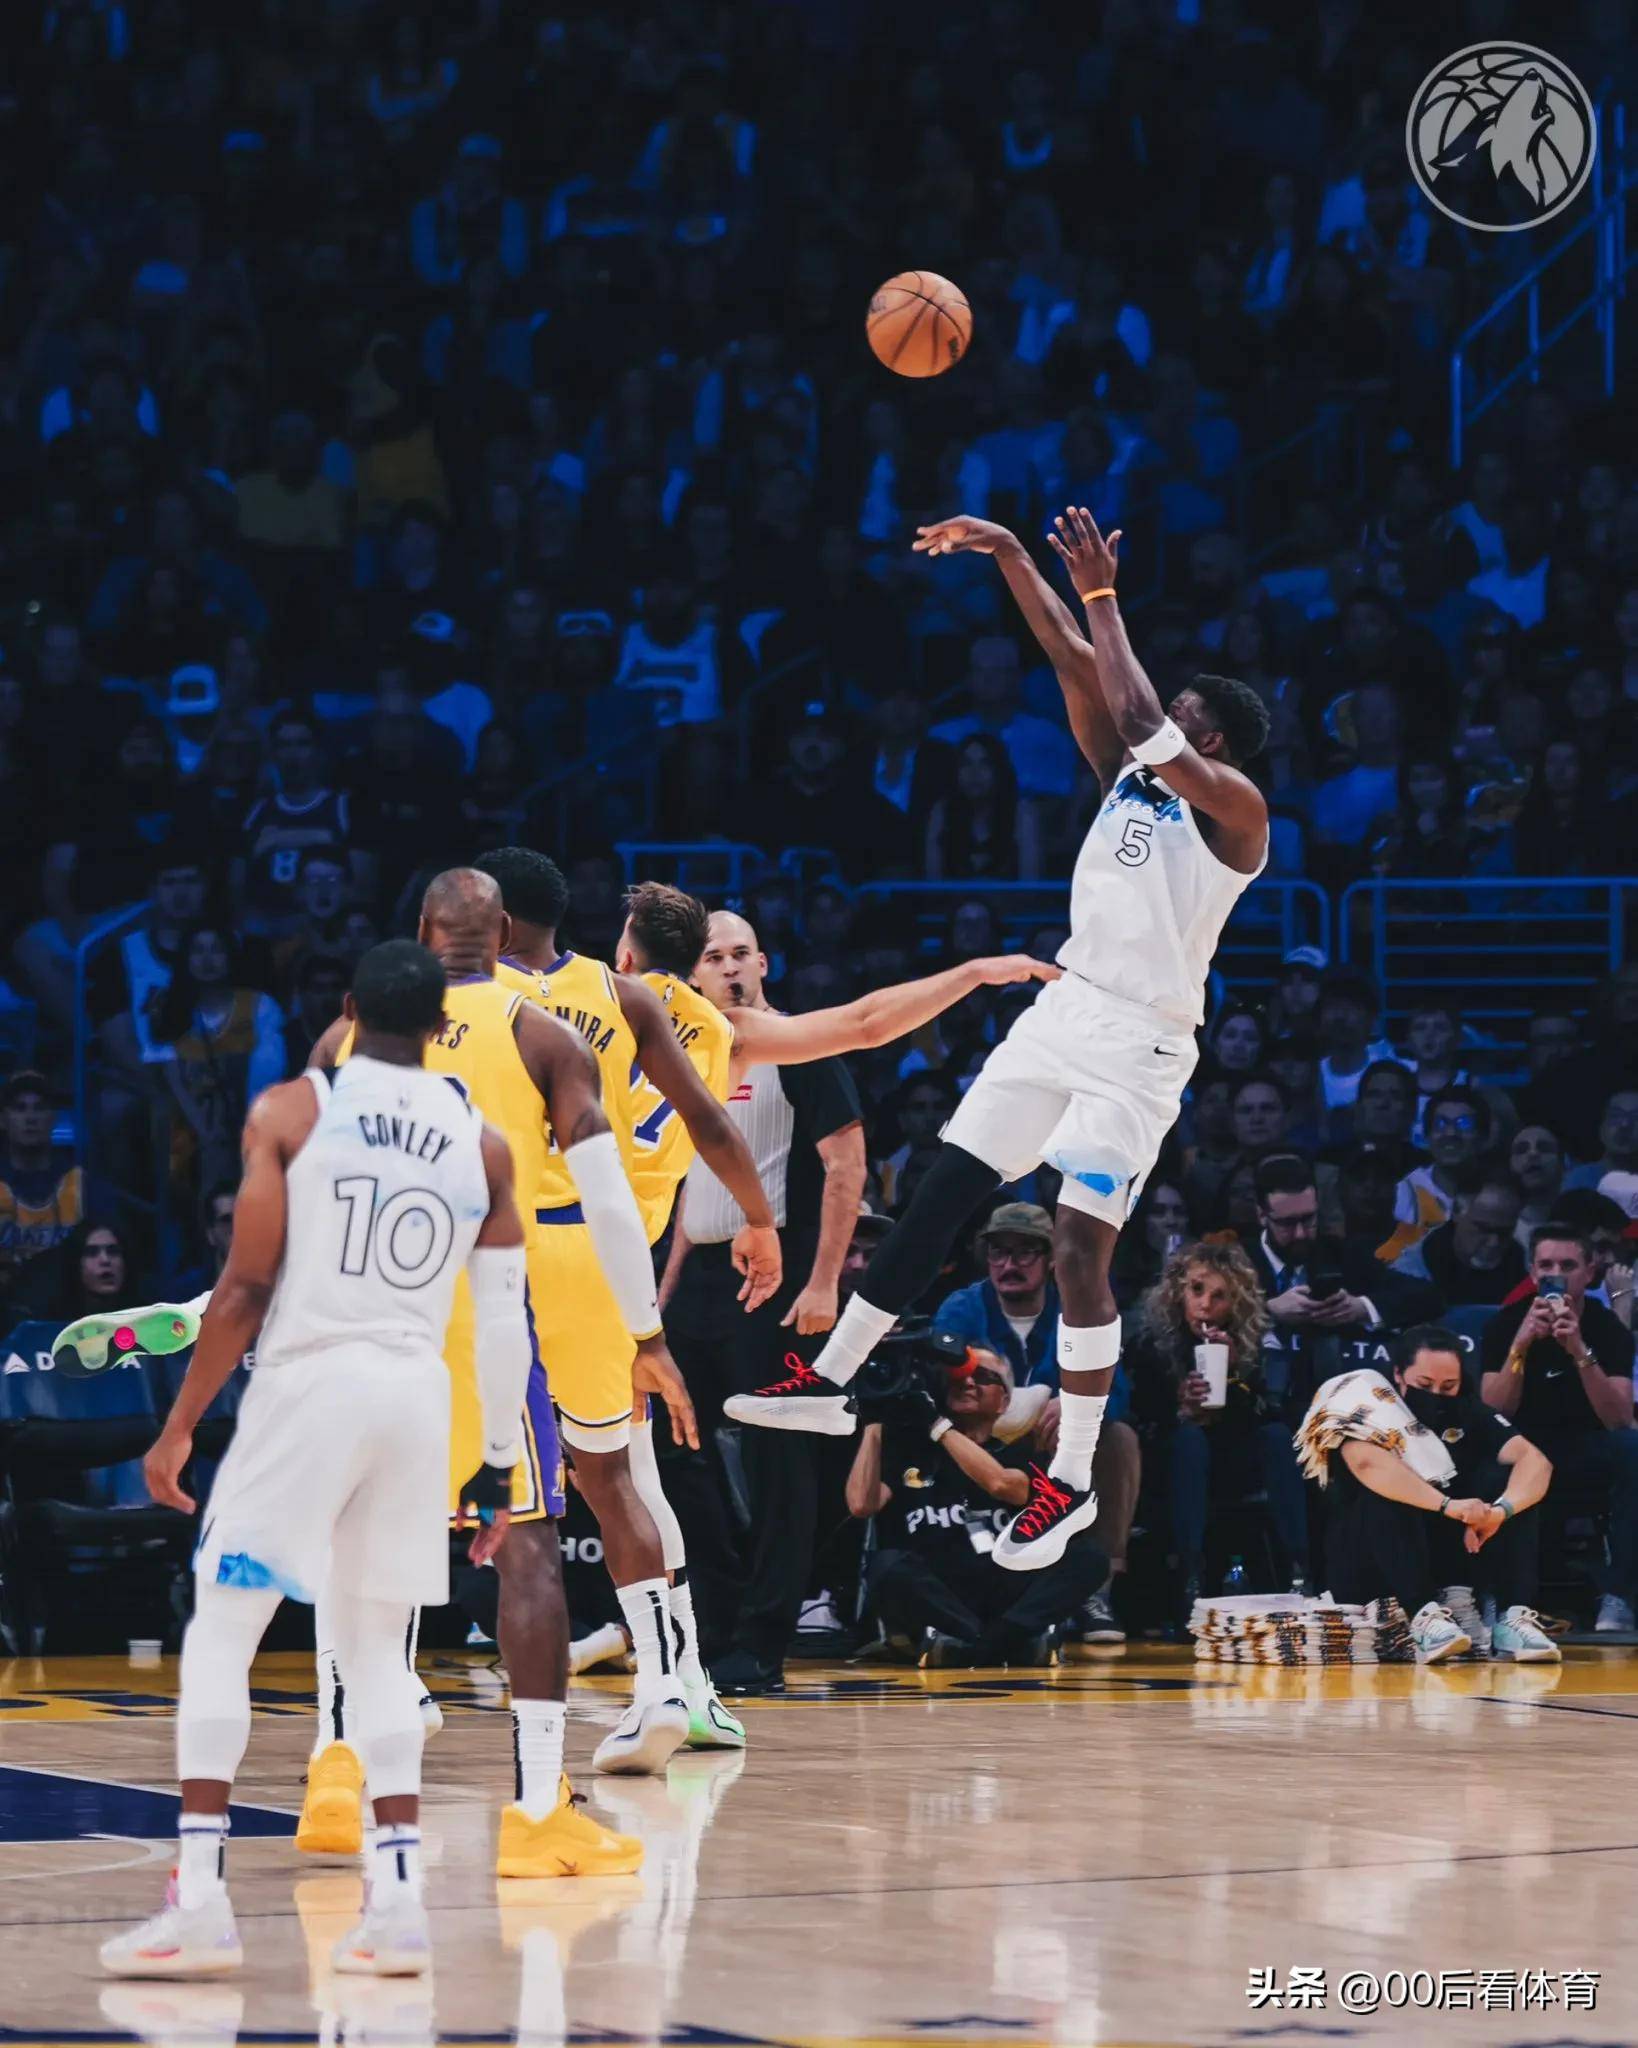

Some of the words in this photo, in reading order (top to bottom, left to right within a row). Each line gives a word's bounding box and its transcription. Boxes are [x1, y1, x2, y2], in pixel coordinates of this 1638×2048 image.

[1115, 818, 1153, 867] 5
[358, 1113, 453, 1164] CONLEY
[334, 1175, 454, 1290] 10
